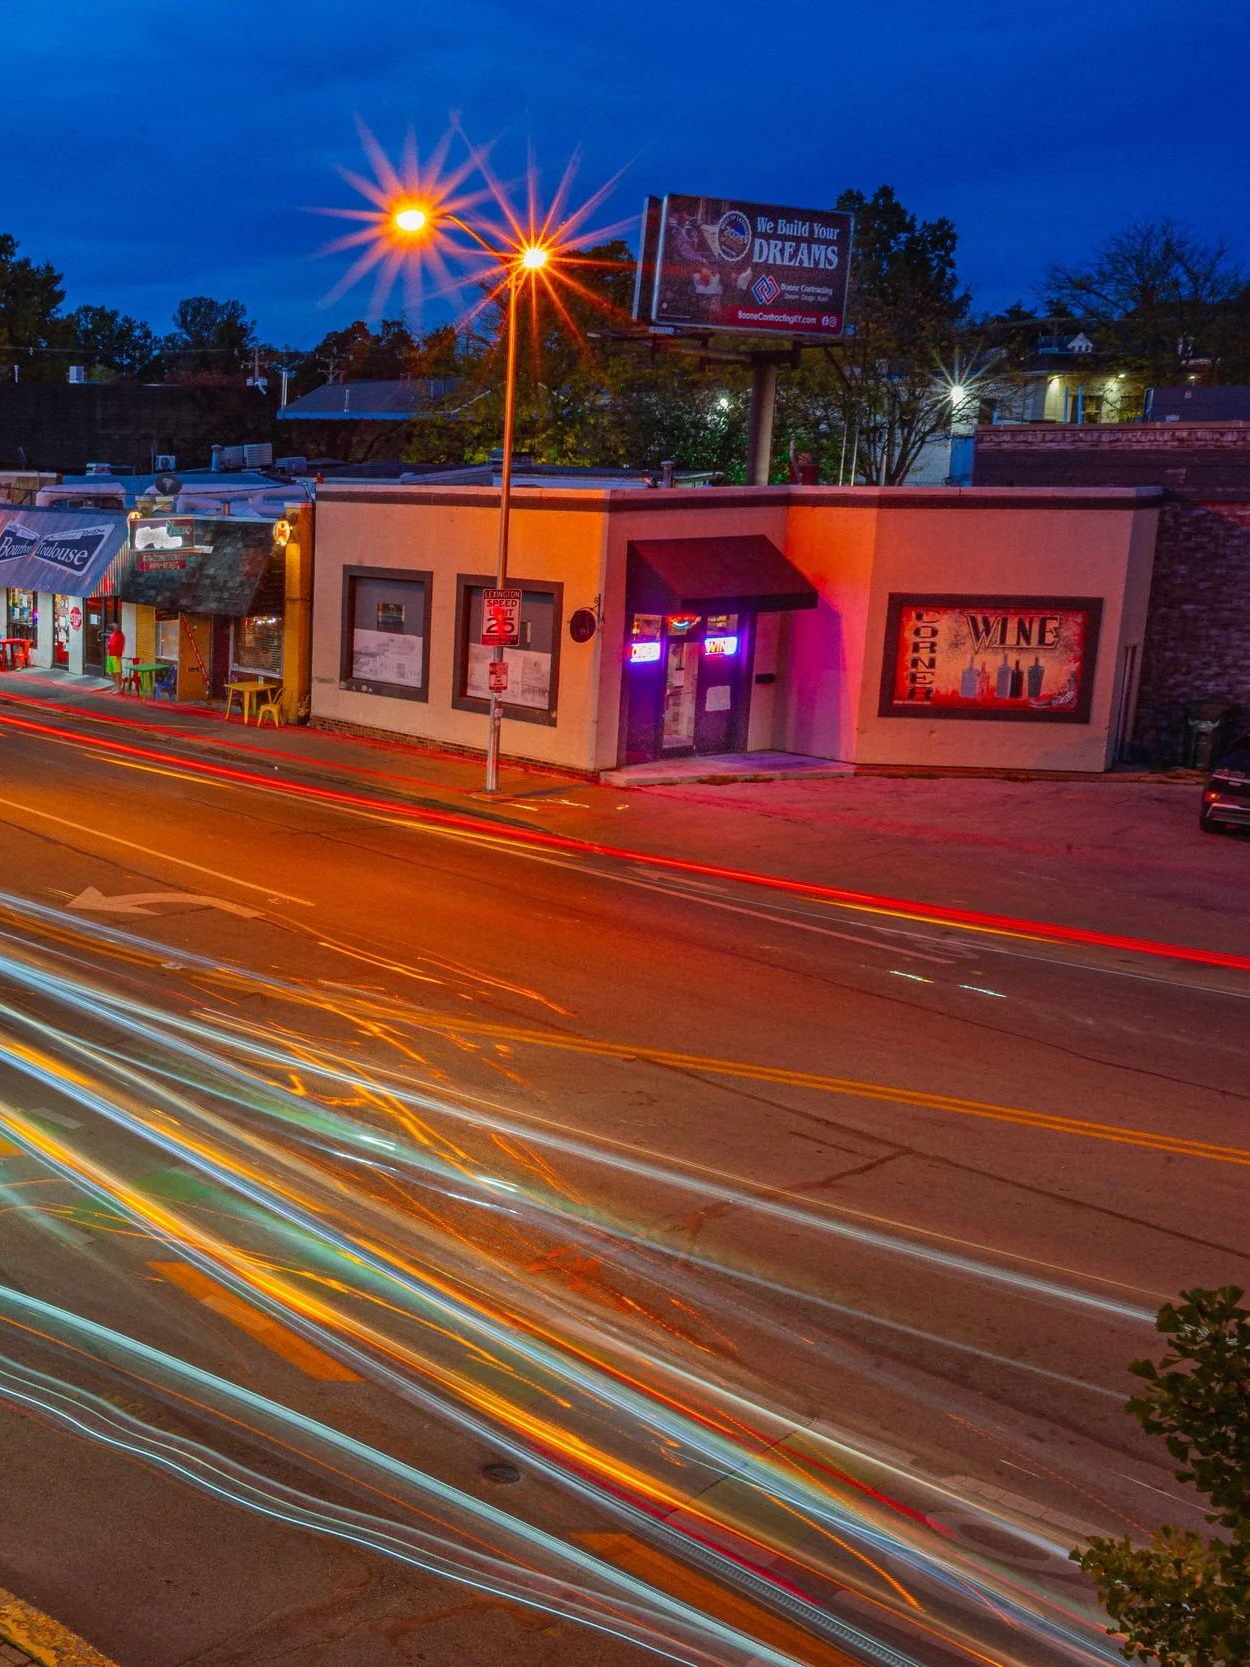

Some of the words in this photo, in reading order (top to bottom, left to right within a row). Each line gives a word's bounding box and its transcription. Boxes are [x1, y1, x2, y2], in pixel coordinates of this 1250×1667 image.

[756, 216, 774, 233] We
[777, 219, 809, 237] Build
[812, 223, 839, 240] Your
[752, 238, 838, 270] DREAMS
[801, 284, 833, 296] Contracting
[737, 310, 817, 324] BooneContractingKY.com
[36, 541, 88, 566] Toulouse
[486, 599, 517, 607] SPEED
[486, 617, 515, 634] 25
[965, 612, 1062, 654] WINE
[908, 609, 940, 699] CORNER
